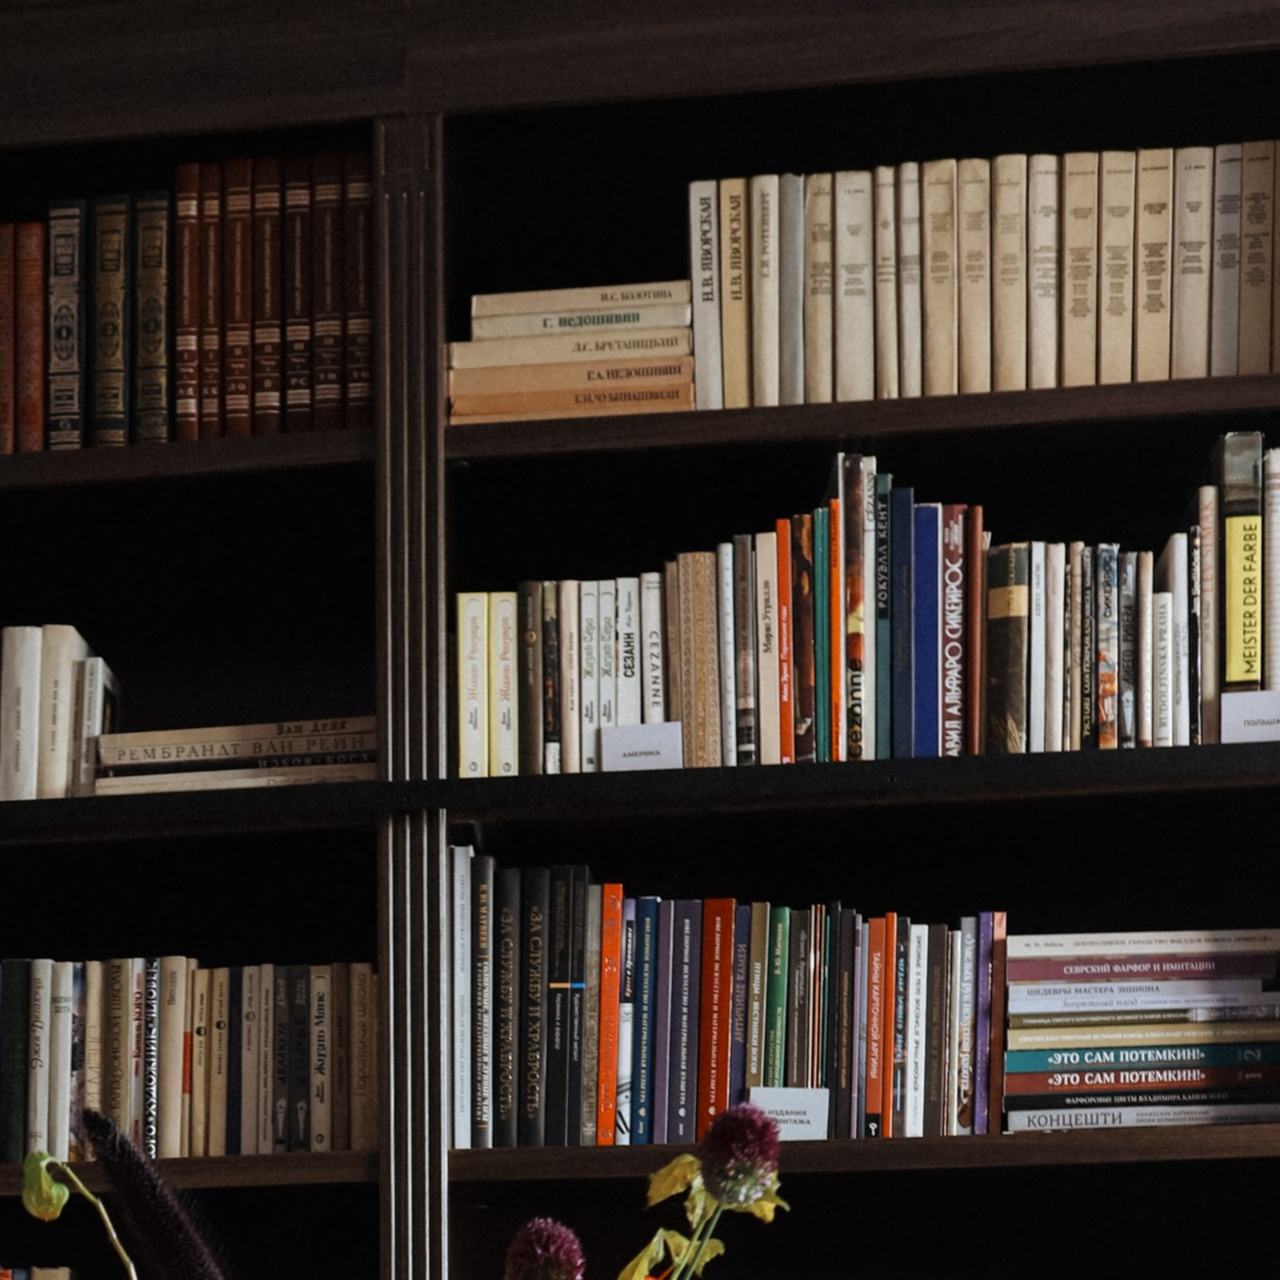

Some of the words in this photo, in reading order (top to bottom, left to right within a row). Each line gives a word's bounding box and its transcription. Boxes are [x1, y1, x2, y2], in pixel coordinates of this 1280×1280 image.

[699, 197, 713, 272] ЯВОРСКАЯ
[730, 195, 742, 270] ЯВОРСКАЯ
[877, 501, 887, 539] КЕНТ
[1243, 523, 1257, 572] FARBE
[878, 544, 888, 609] РОКУЭЛЛ
[1102, 555, 1113, 618] СИКЕЙРОС
[1243, 575, 1257, 606] DER
[944, 558, 963, 639] СИКЕЙРОС
[1121, 604, 1133, 643] РИВЕРА
[1157, 604, 1168, 642] PRAHA
[1244, 610, 1257, 674] MEISTER
[622, 632, 635, 678] СЕЗАНН
[650, 630, 661, 708] CEZANNE
[944, 641, 963, 716] АЛЬФАРО
[117, 743, 242, 762] РЕМБРАНДТ
[252, 740, 293, 755] ВАН
[307, 735, 366, 752] РЕЙН
[622, 750, 661, 758] АМЕРИКА
[500, 906, 514, 933] «ЗА
[529, 905, 542, 932] «ЗА
[500, 937, 514, 1001] СЛУЖБУ
[528, 936, 543, 1001] СЛУЖБУ
[737, 943, 747, 981] КАМЕИ
[752, 962, 762, 994] ПТИЦЫ
[871, 952, 882, 983] ТАЙНЫ
[1063, 964, 1111, 975] СЕВРСКИЙ
[1112, 963, 1151, 974] ФАРФОР
[1153, 963, 1160, 972] И
[1162, 961, 1215, 972] ИМИТАЦИИ
[109, 964, 122, 1010] ШКОЛЫ
[144, 961, 157, 1023] ЧЕЛОВЕК
[682, 964, 690, 1006] ИСКУССТВО
[712, 962, 721, 1004] ИСКУССТВО
[1027, 986, 1072, 996] ШЕДЕВРЫ
[1074, 985, 1115, 995] МАСТЕРА
[133, 991, 142, 1021] КОРО
[314, 991, 325, 1027] Мане
[500, 1006, 513, 1017] И
[528, 1006, 541, 1017] И
[735, 983, 745, 1043] АНТИЧНЫЕ
[751, 1002, 761, 1045] ВЕСТНИКИ
[871, 985, 881, 1041] КАРТОЧНОЙ
[314, 1029, 326, 1076] Жизнь
[680, 1014, 689, 1069] МАТЕРИАЛЬНАЯ
[711, 1012, 720, 1067] МАТЕРИАЛЬНАЯ
[1047, 1051, 1079, 1065] «ЭТО
[1083, 1050, 1115, 1064] САМ
[1119, 1048, 1206, 1063] ПОТЕМКИН!»
[144, 1028, 158, 1114] ХУДОЖНИК
[499, 1021, 513, 1120] ХРАБРОСТЬ»
[526, 1021, 541, 1120] ХРАБРОСТЬ»
[750, 1047, 759, 1074] БОГОВ
[1047, 1073, 1079, 1086] «ЭТО
[1083, 1071, 1115, 1085] САМ
[1119, 1069, 1206, 1083] ПОТЕМКИН!»
[678, 1071, 687, 1105] КУЛЬТУРА
[709, 1070, 718, 1103] КУЛЬТУРА
[1065, 1095, 1113, 1104] ФАРФОРОВЫЕ
[1114, 1095, 1136, 1103] ЦВЕТЫ
[1137, 1094, 1179, 1102] ВЛАДИМИРА
[768, 1109, 807, 1117] ИЗДАНИЯ
[1026, 1113, 1123, 1128] КОНЦЕШТИ
